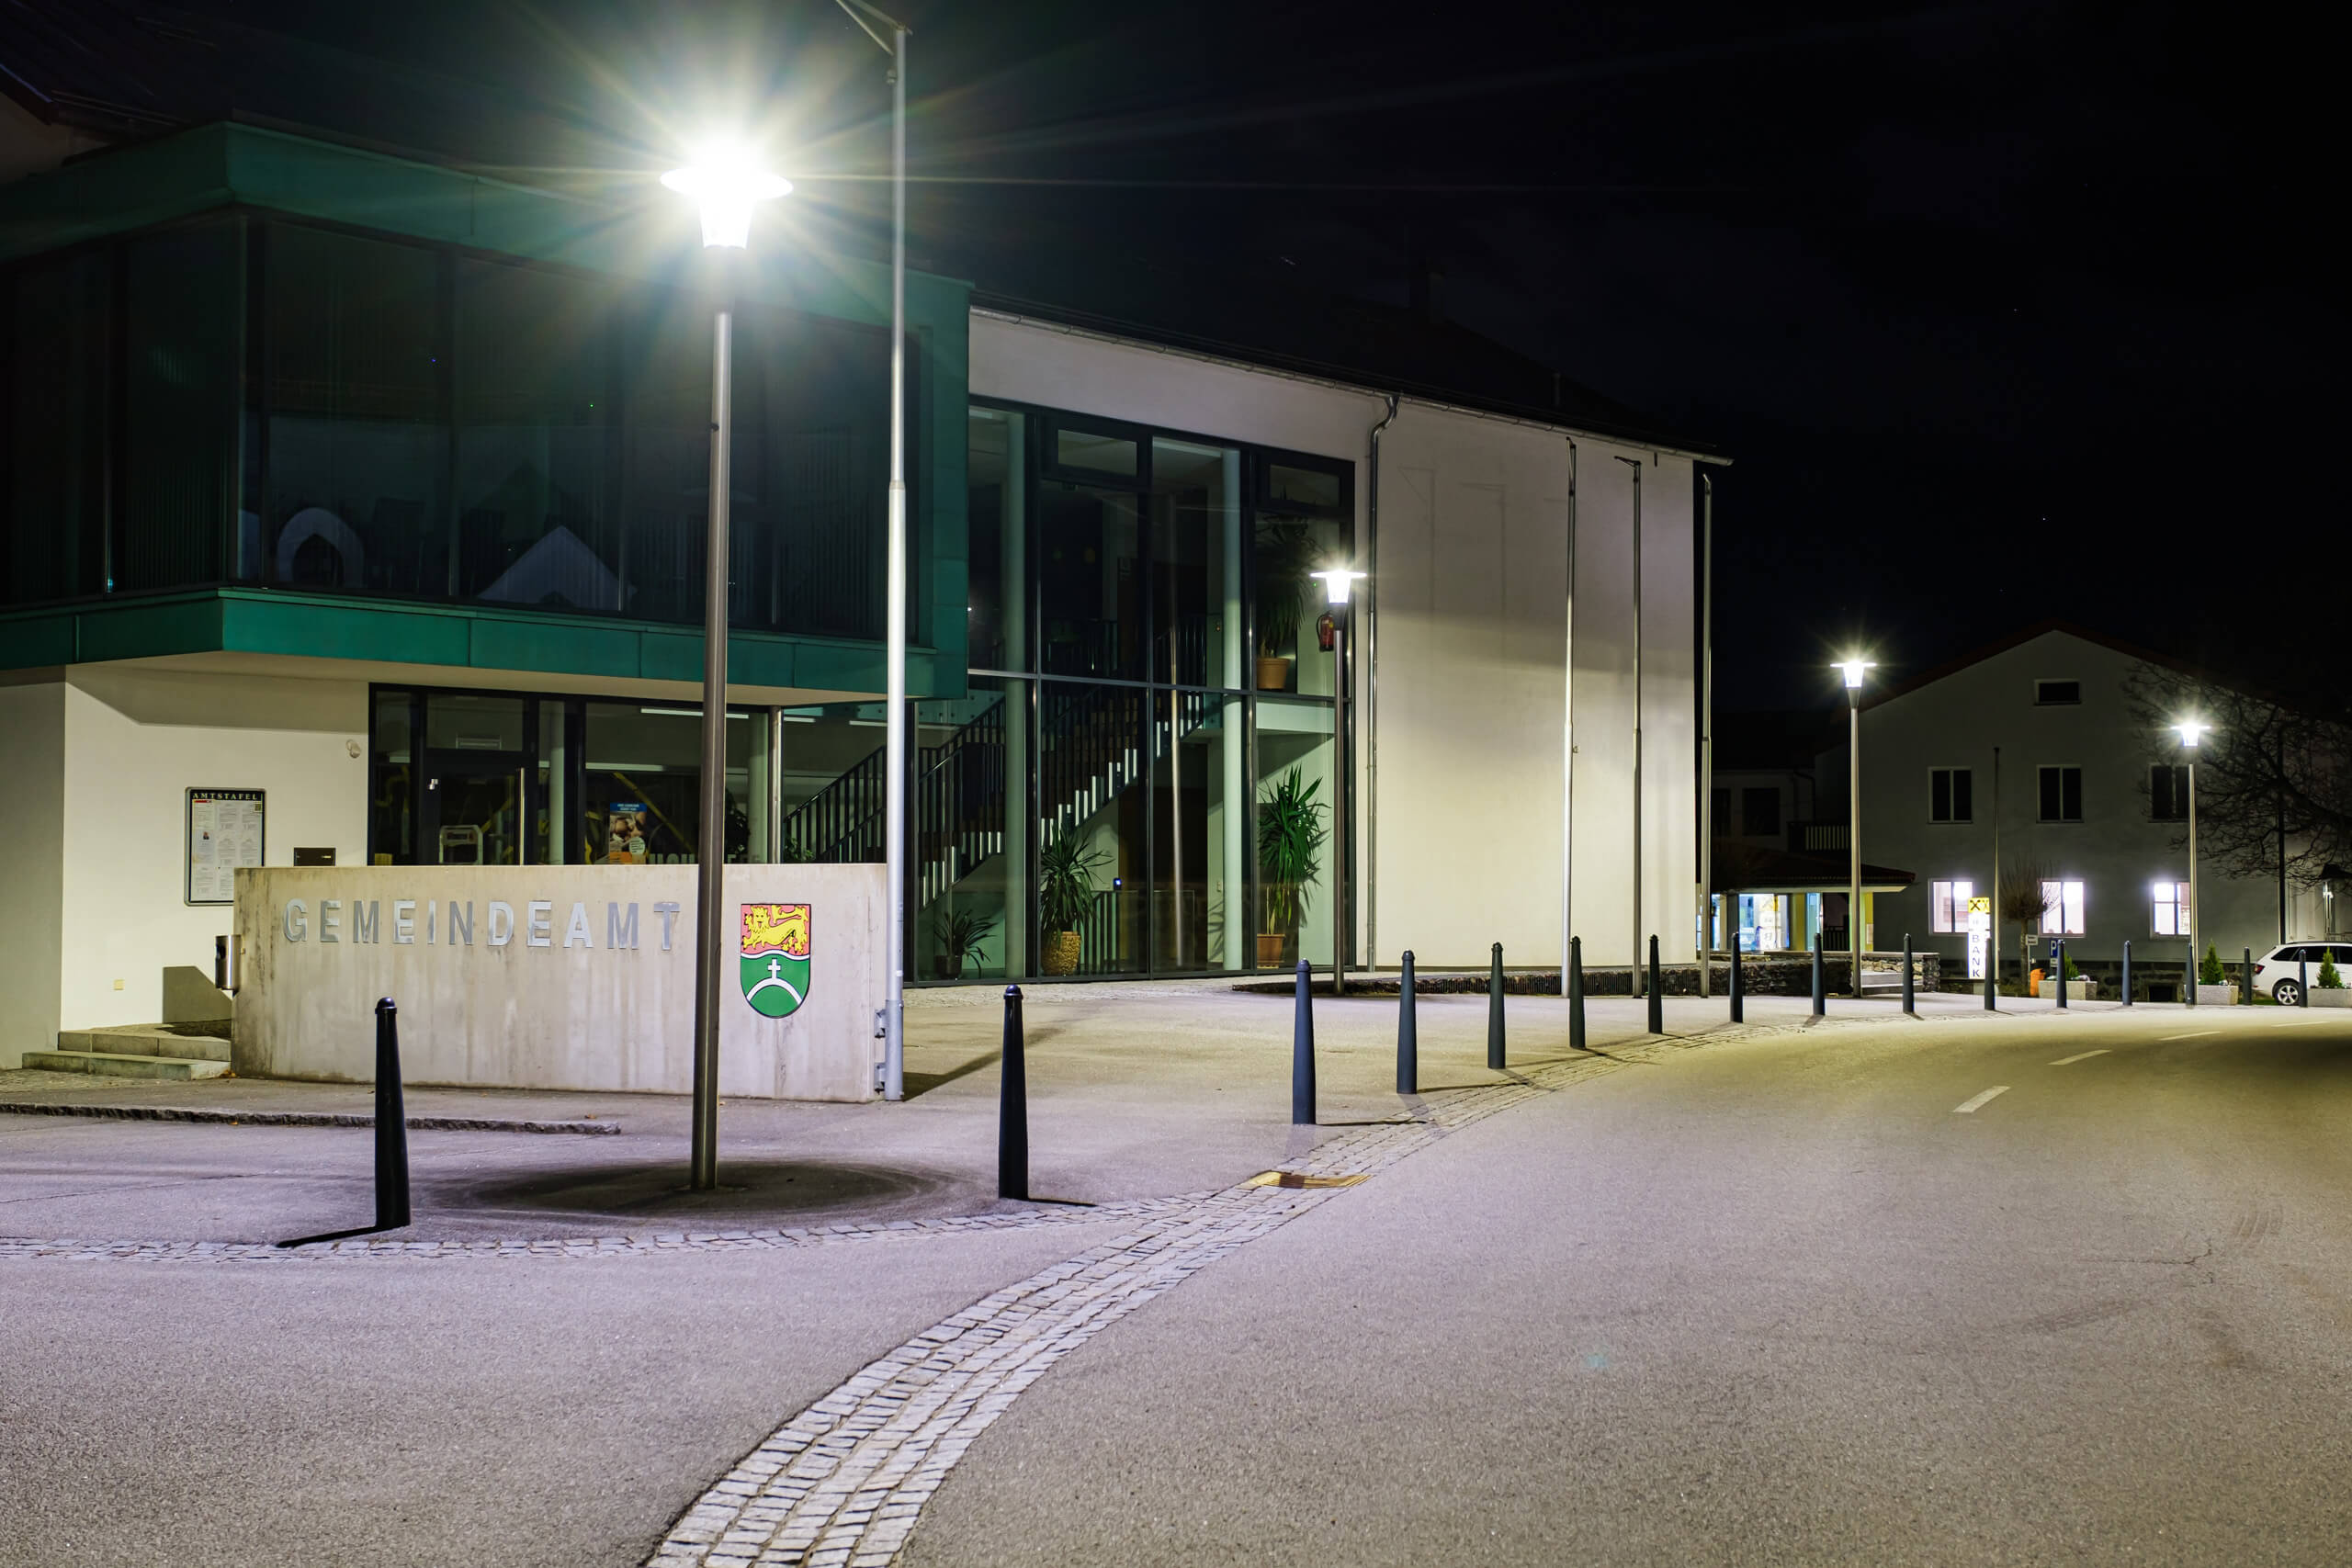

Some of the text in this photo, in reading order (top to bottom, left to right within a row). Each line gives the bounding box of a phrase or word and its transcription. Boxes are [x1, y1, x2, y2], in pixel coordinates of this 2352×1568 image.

[284, 898, 681, 951] GEMEINDEAMT
[1972, 934, 1981, 977] BANK
[2050, 940, 2057, 956] P
